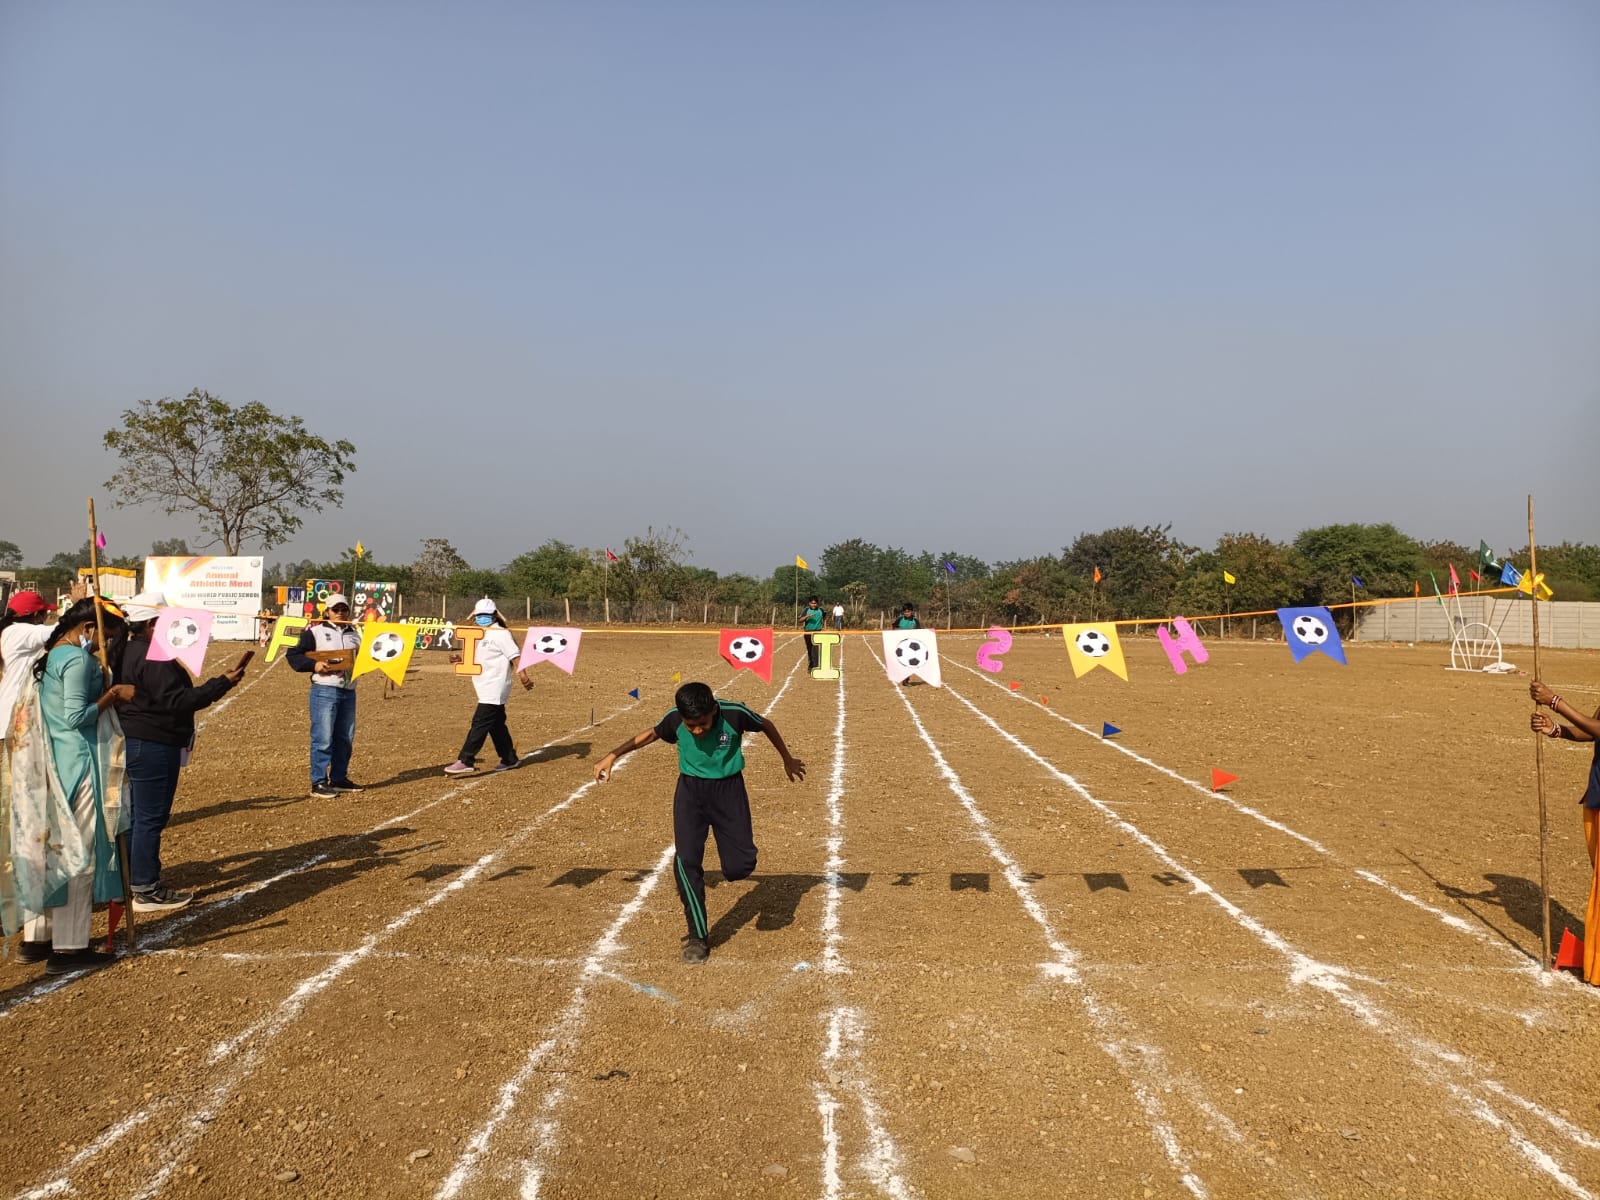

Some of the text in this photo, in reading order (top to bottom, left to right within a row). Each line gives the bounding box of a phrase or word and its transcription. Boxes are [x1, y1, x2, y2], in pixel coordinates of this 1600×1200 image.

[205, 571, 239, 579] Annual
[408, 616, 438, 625] SPEED
[264, 616, 309, 663] F
[455, 628, 485, 676] I
[812, 633, 841, 680] I
[1157, 616, 1210, 675] H
